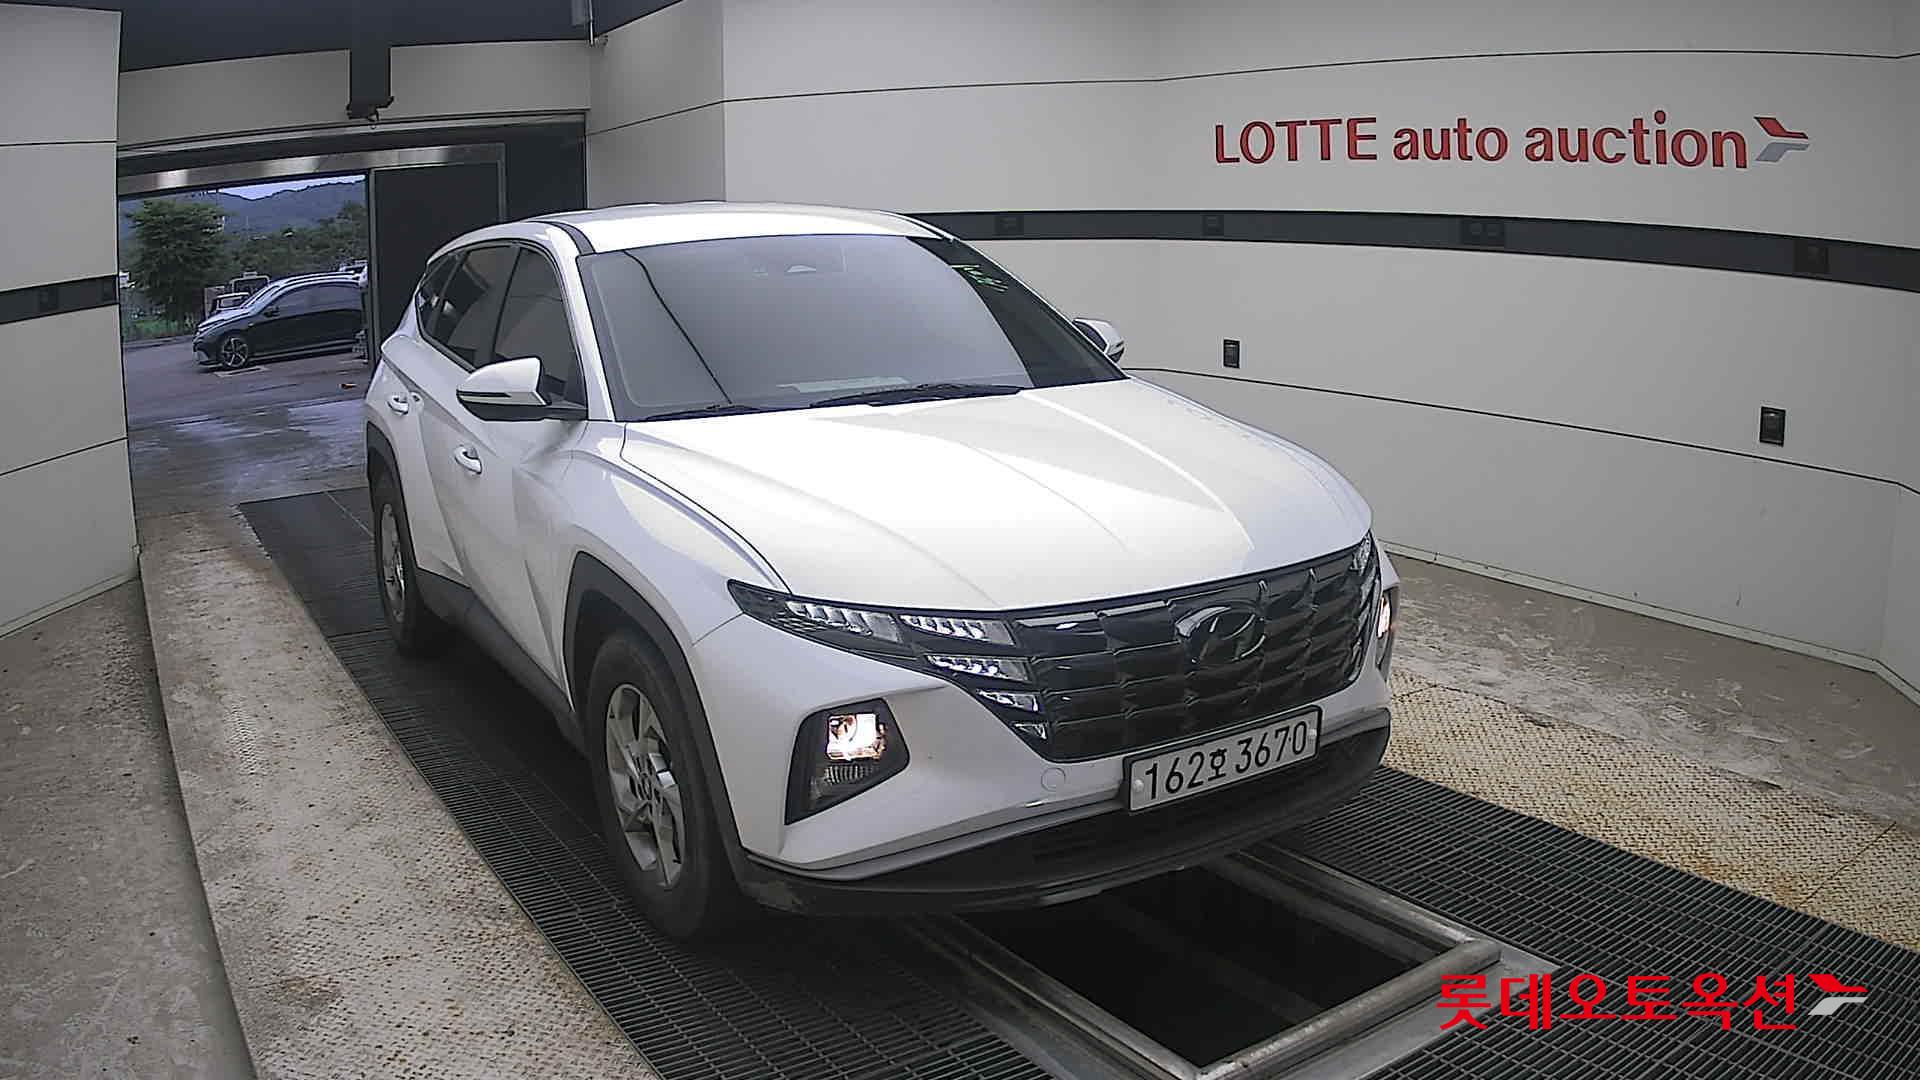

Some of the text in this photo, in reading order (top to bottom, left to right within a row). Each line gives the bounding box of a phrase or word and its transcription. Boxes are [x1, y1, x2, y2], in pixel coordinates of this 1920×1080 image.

[1215, 110, 1747, 168] LOTTE auto auction
[1236, 721, 1307, 773] 3670
